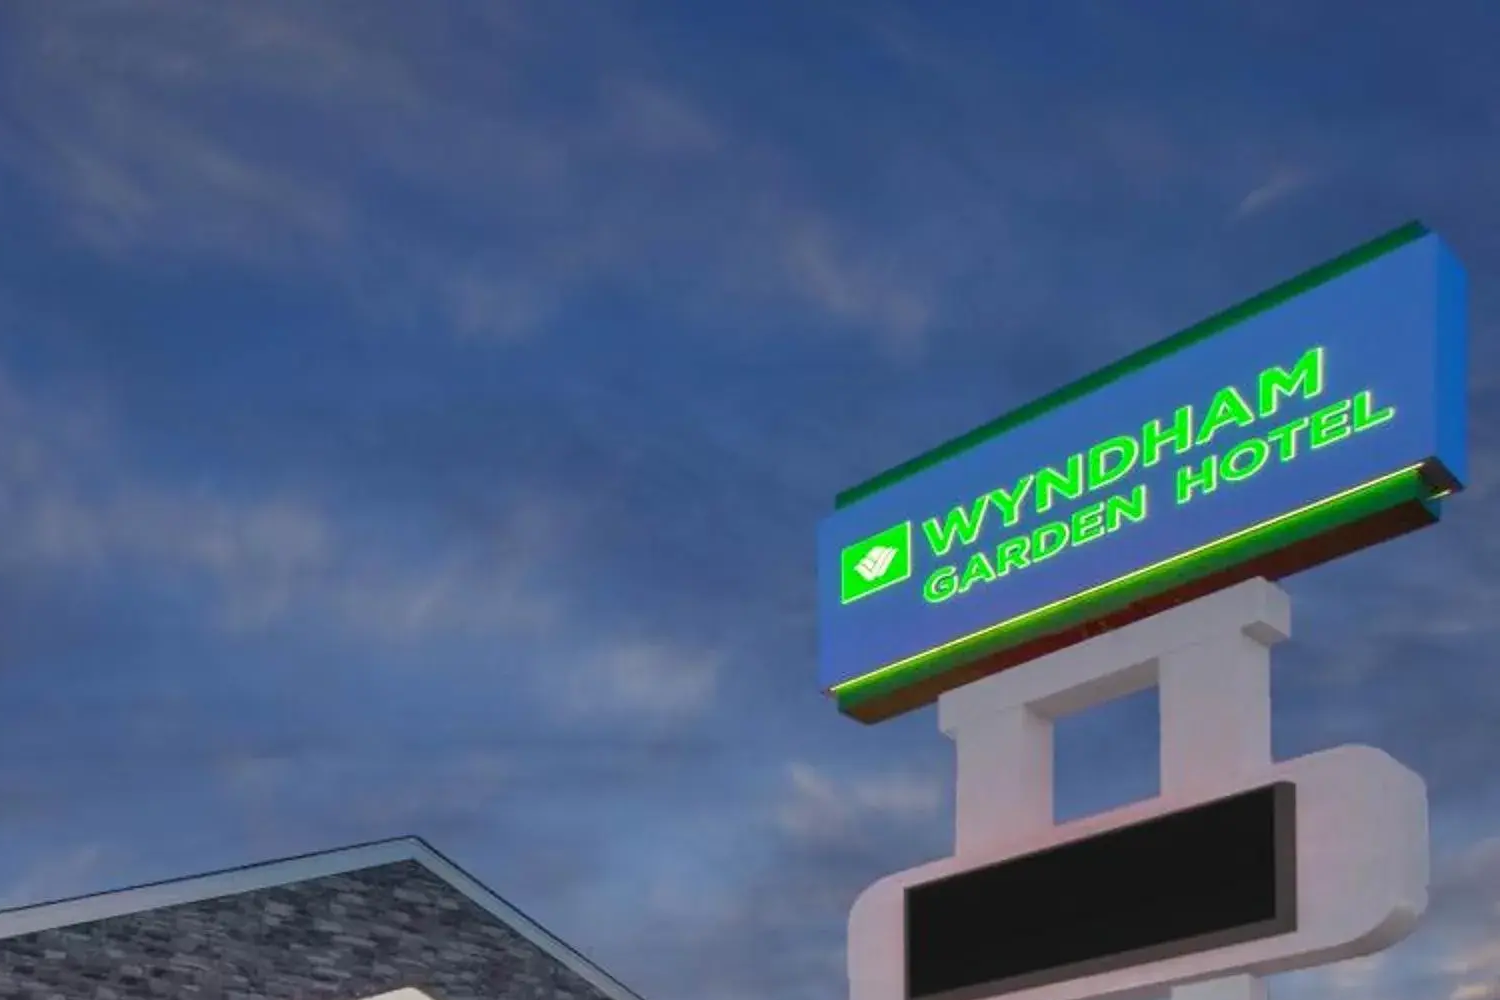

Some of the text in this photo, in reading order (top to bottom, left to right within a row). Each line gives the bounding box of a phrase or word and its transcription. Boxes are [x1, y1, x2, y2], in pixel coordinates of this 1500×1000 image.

[921, 347, 1324, 556] WYNDHAM
[923, 390, 1395, 604] GARDEN HOTEL
